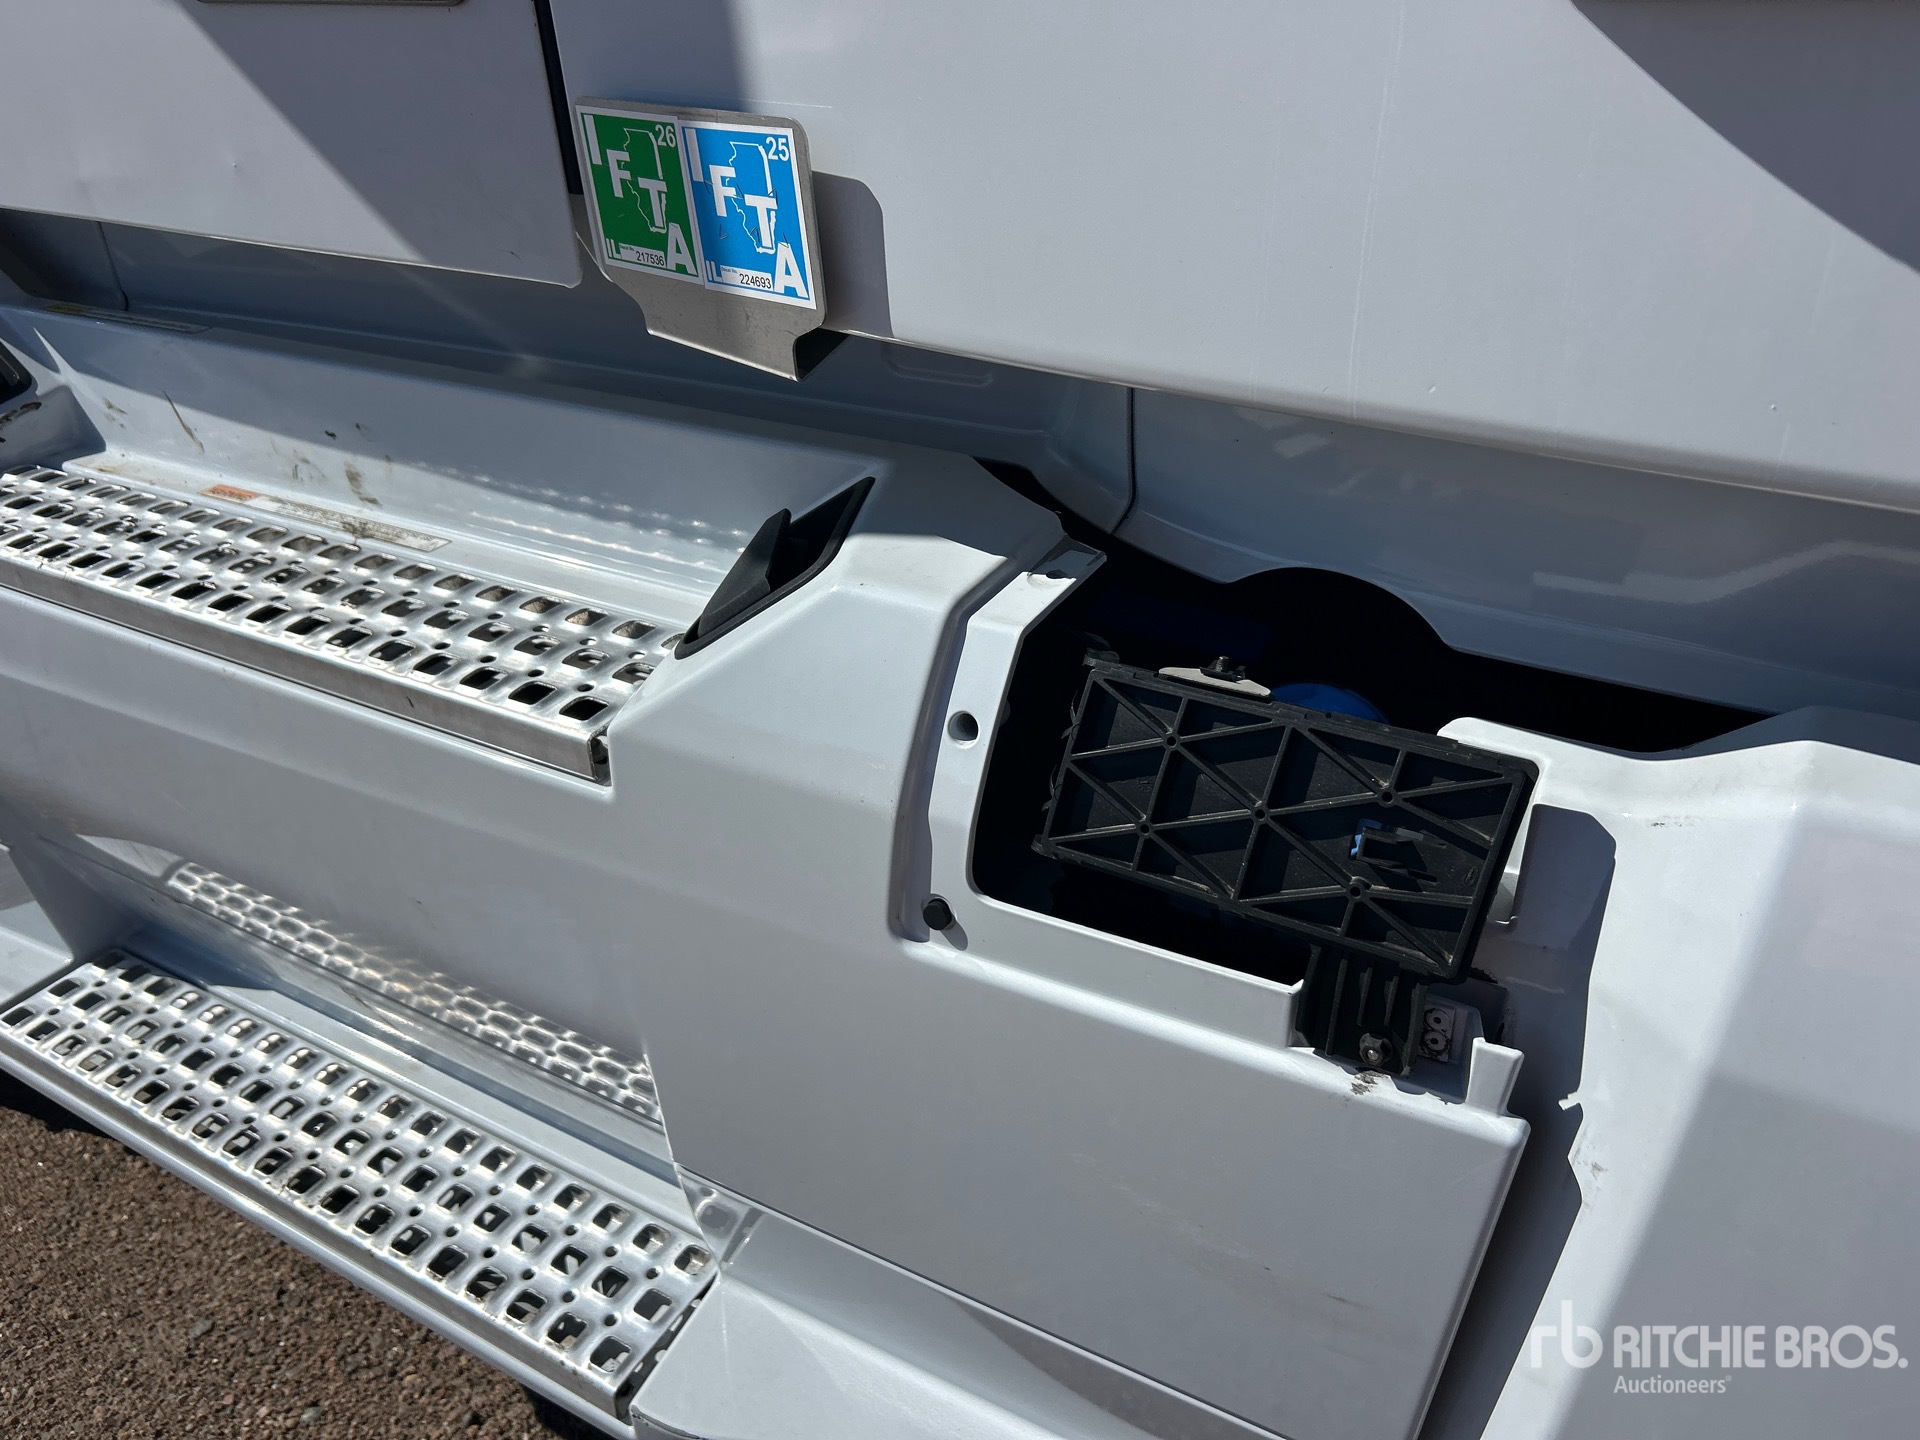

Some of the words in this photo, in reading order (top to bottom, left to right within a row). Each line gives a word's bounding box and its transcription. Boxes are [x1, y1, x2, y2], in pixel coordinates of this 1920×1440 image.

[654, 124, 677, 148] 26
[765, 136, 790, 162] 25
[605, 238, 621, 259] IL
[636, 250, 665, 267] 217536
[705, 260, 722, 282] IL
[739, 273, 772, 289] 224693
